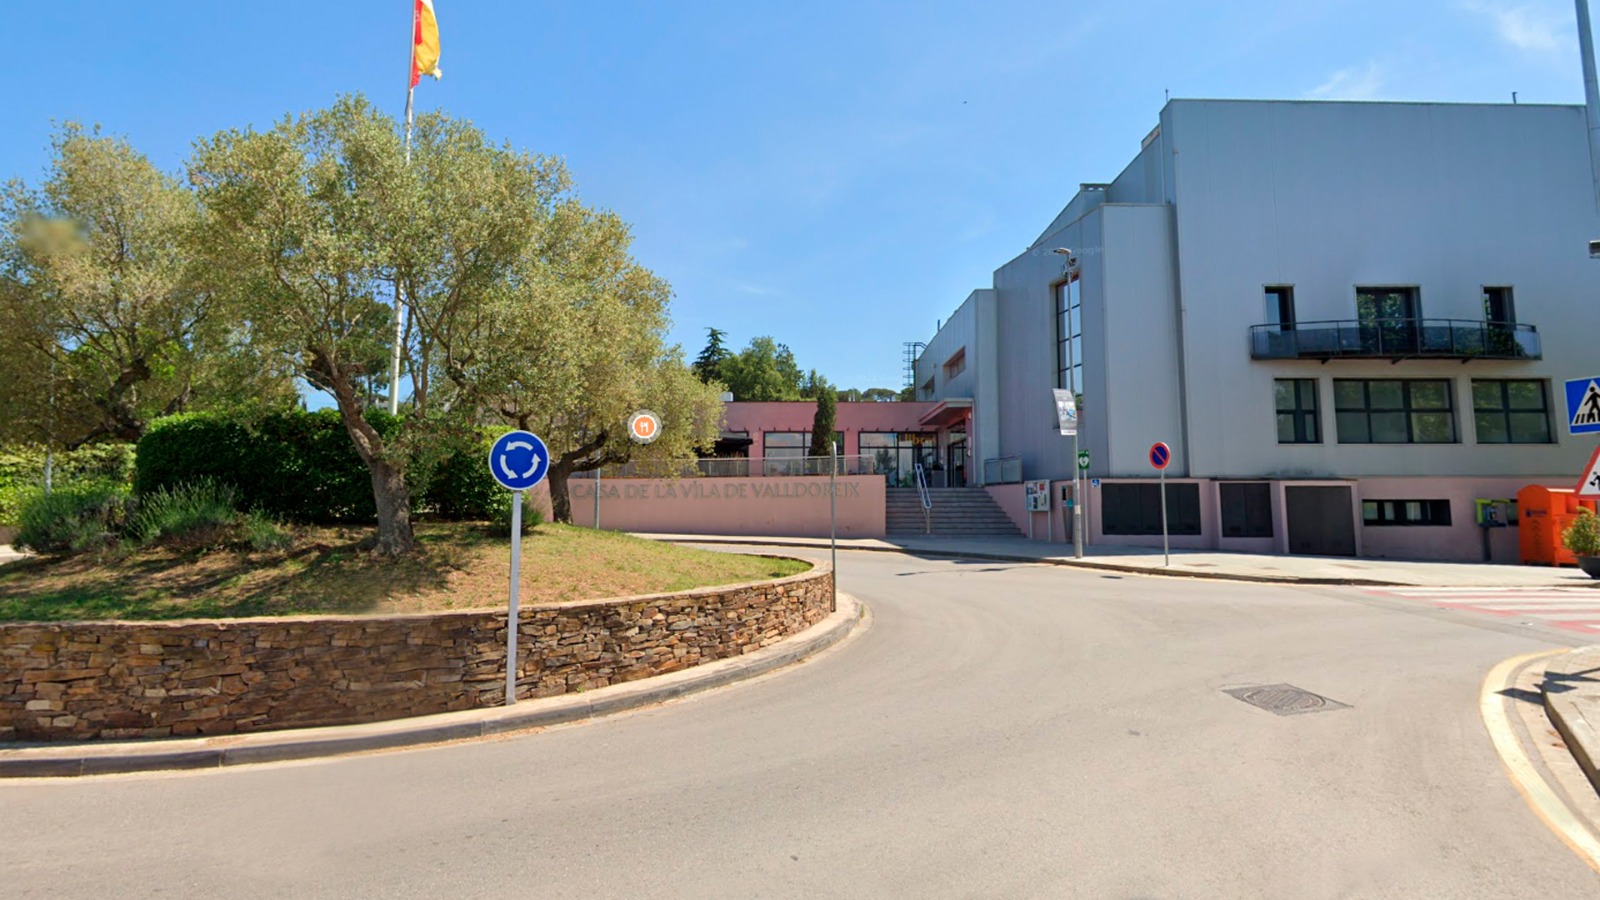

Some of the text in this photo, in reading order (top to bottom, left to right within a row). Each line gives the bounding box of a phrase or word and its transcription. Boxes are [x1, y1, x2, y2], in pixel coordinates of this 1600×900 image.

[571, 483, 621, 499] CASA
[624, 483, 650, 499] DE
[654, 483, 678, 499] LA
[724, 483, 748, 499] DE
[750, 482, 861, 498] VALLDOREIX
